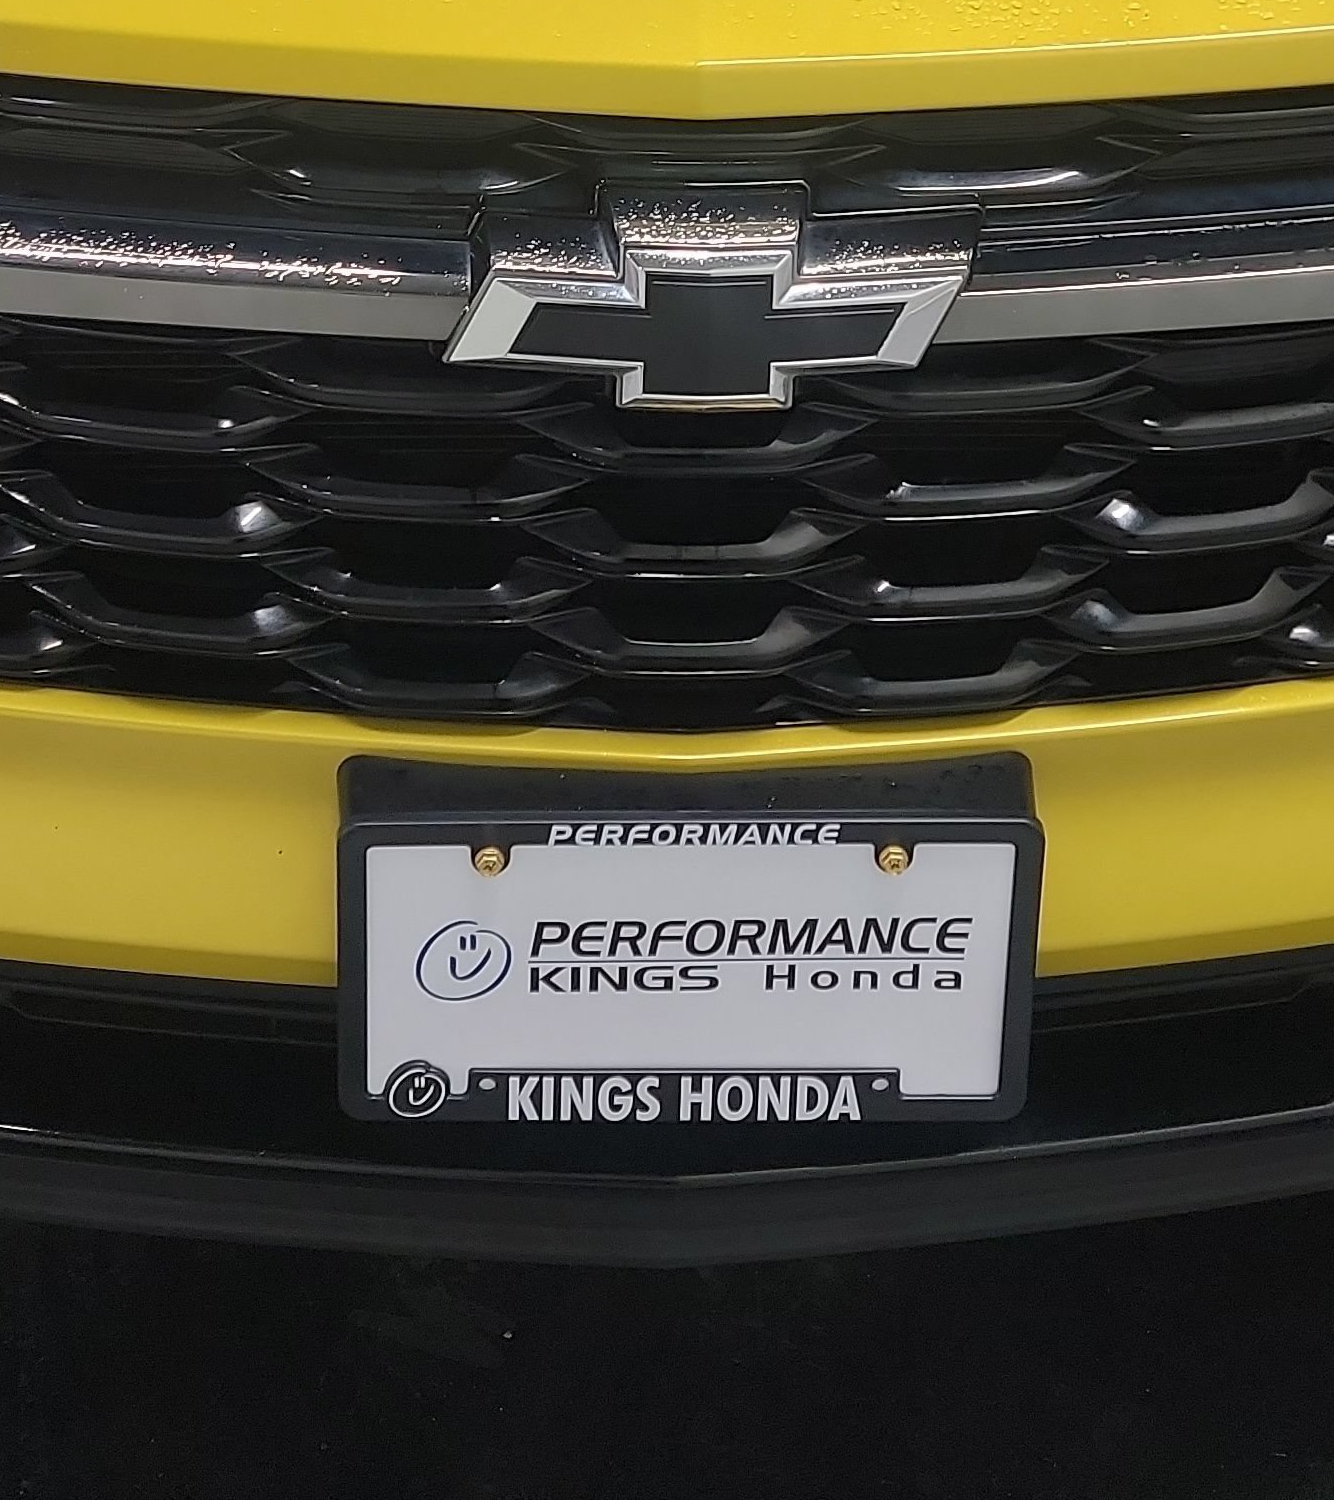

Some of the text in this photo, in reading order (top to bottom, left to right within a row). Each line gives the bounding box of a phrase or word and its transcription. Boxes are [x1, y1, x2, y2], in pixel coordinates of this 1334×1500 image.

[547, 823, 841, 847] PERFORMANCE
[530, 918, 973, 958] PERFORMANCE
[528, 963, 963, 993] KINGS Honda
[507, 1076, 862, 1122] KINGS HONDA
